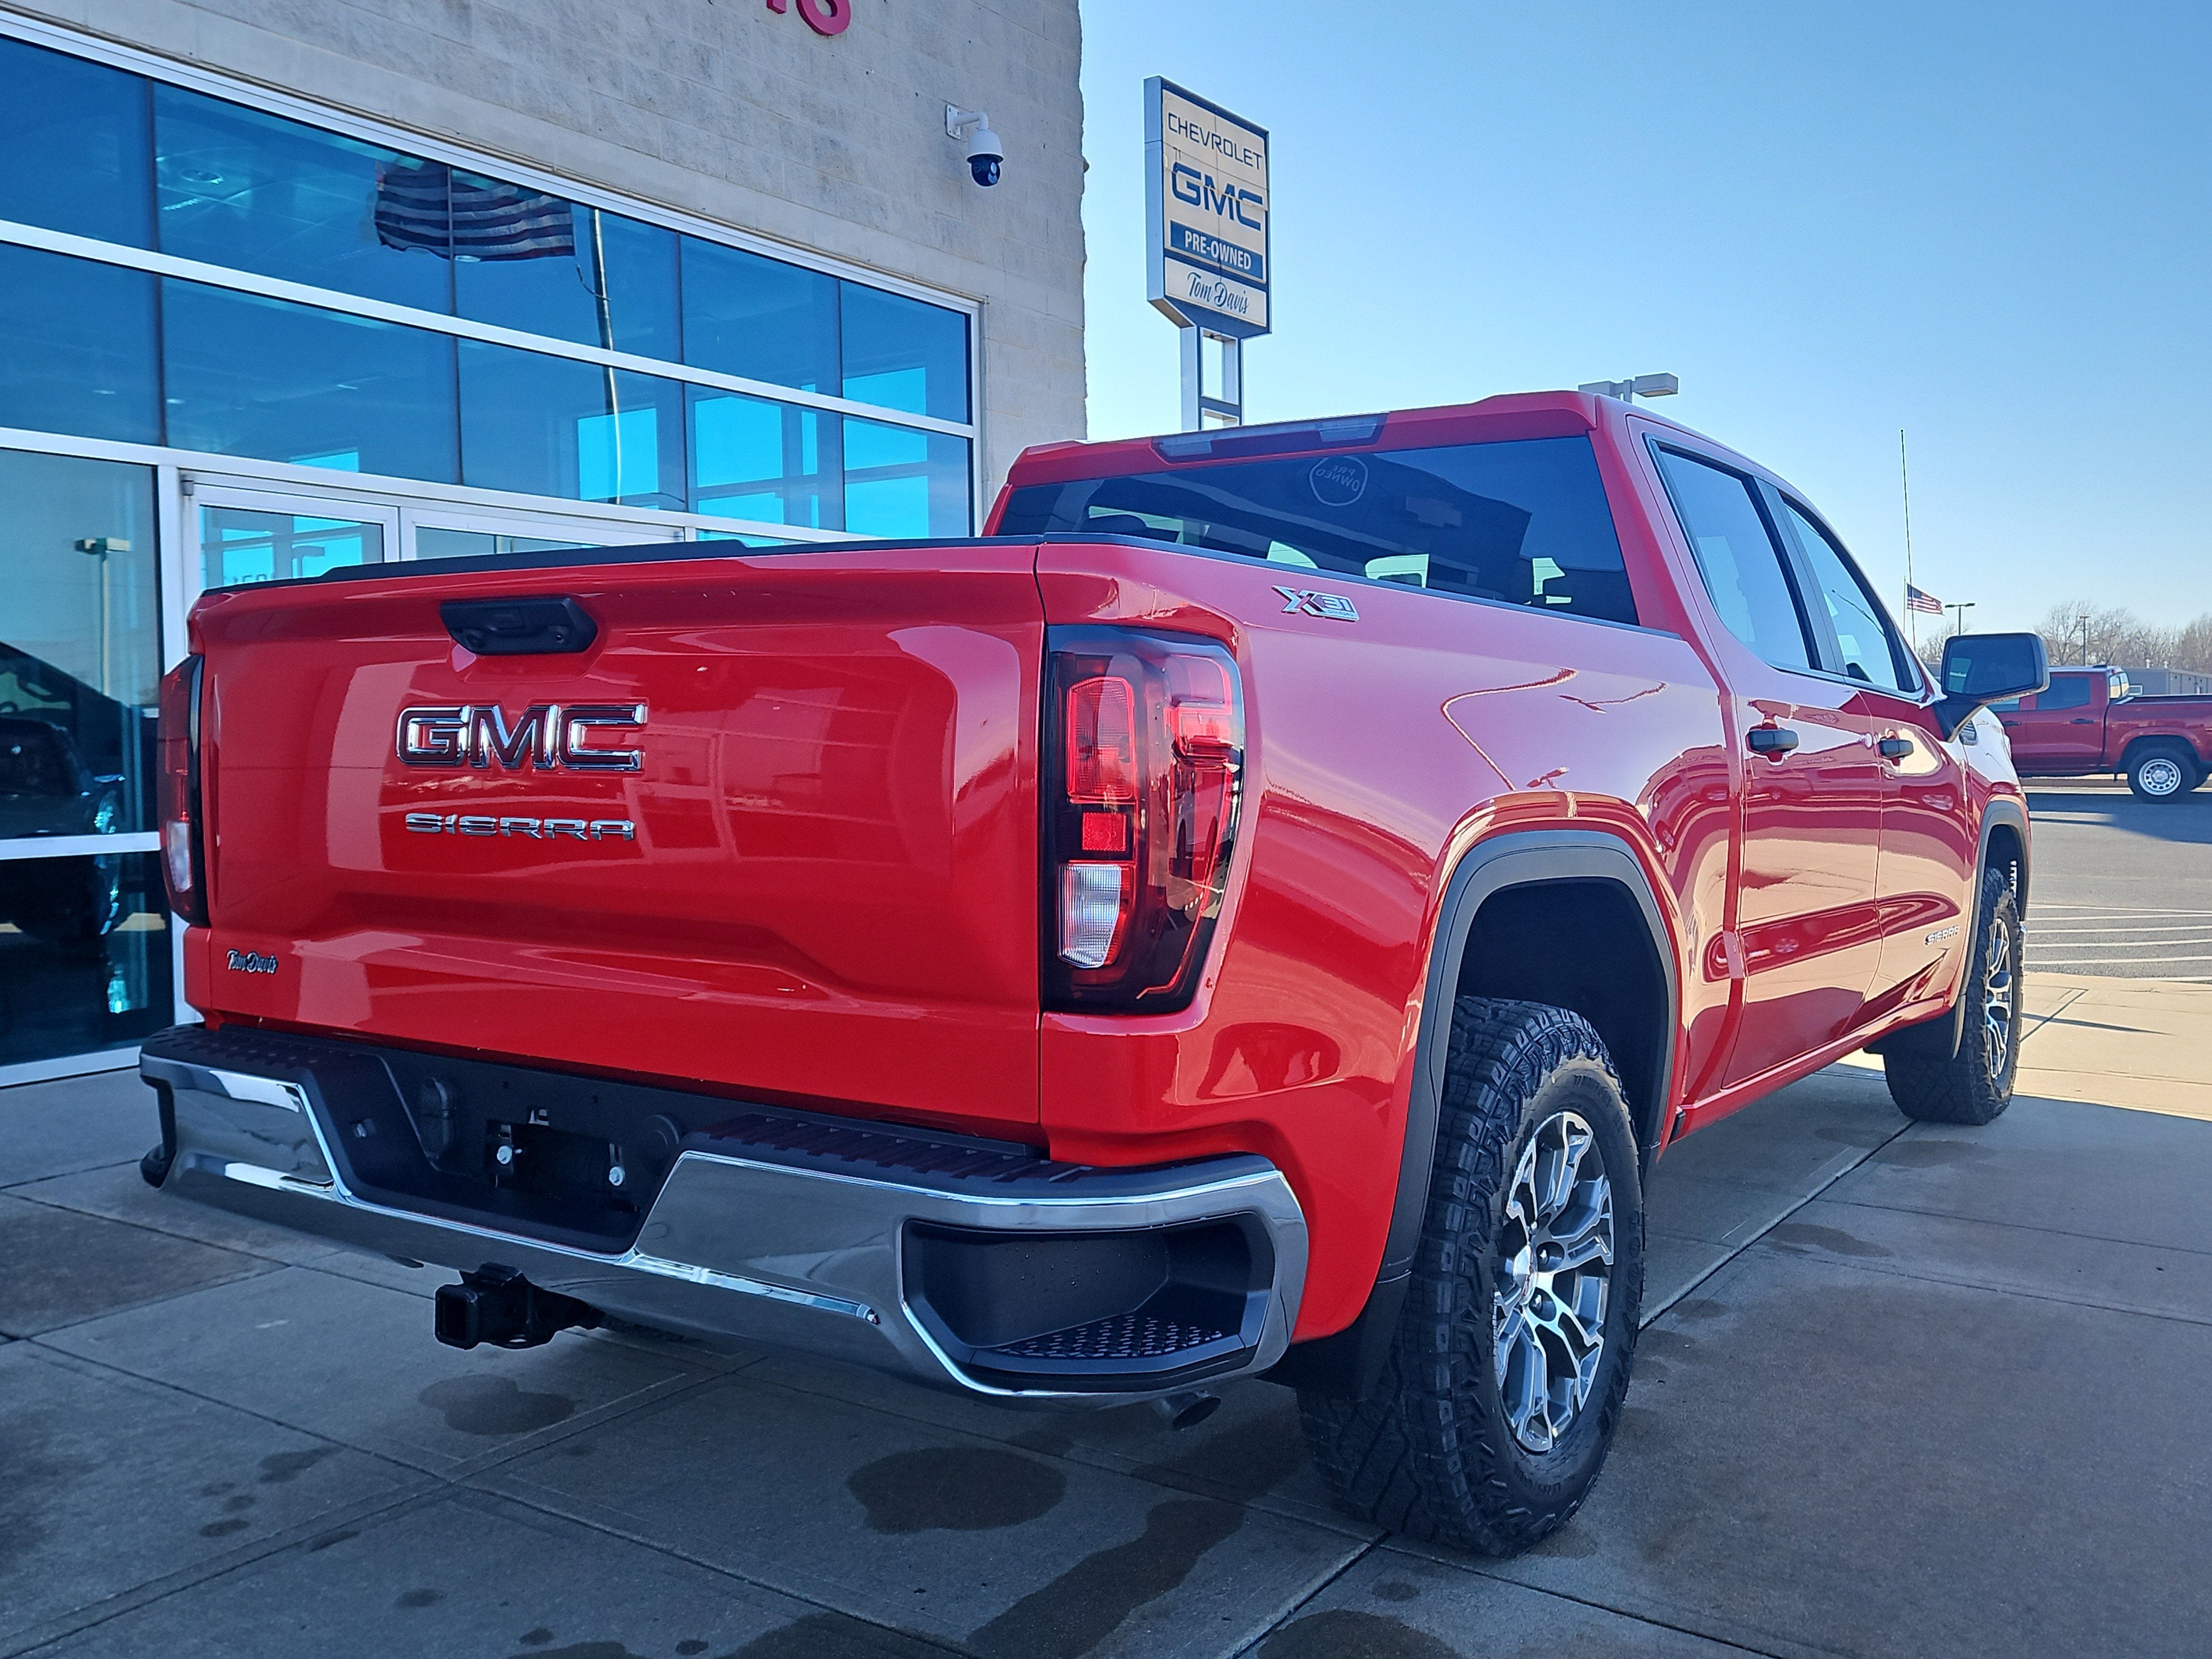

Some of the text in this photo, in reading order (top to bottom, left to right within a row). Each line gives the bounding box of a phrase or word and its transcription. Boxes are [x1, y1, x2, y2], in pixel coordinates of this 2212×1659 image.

[1168, 112, 1262, 170] CHEVROLET
[1172, 162, 1263, 232] GMC
[1185, 230, 1251, 270] PRE-OWNED
[1187, 272, 1249, 314] Tom Davis
[1271, 585, 1356, 616] X31
[396, 704, 647, 770] GMC
[406, 813, 635, 840] SIERRA
[1925, 925, 1959, 946] SIERRA
